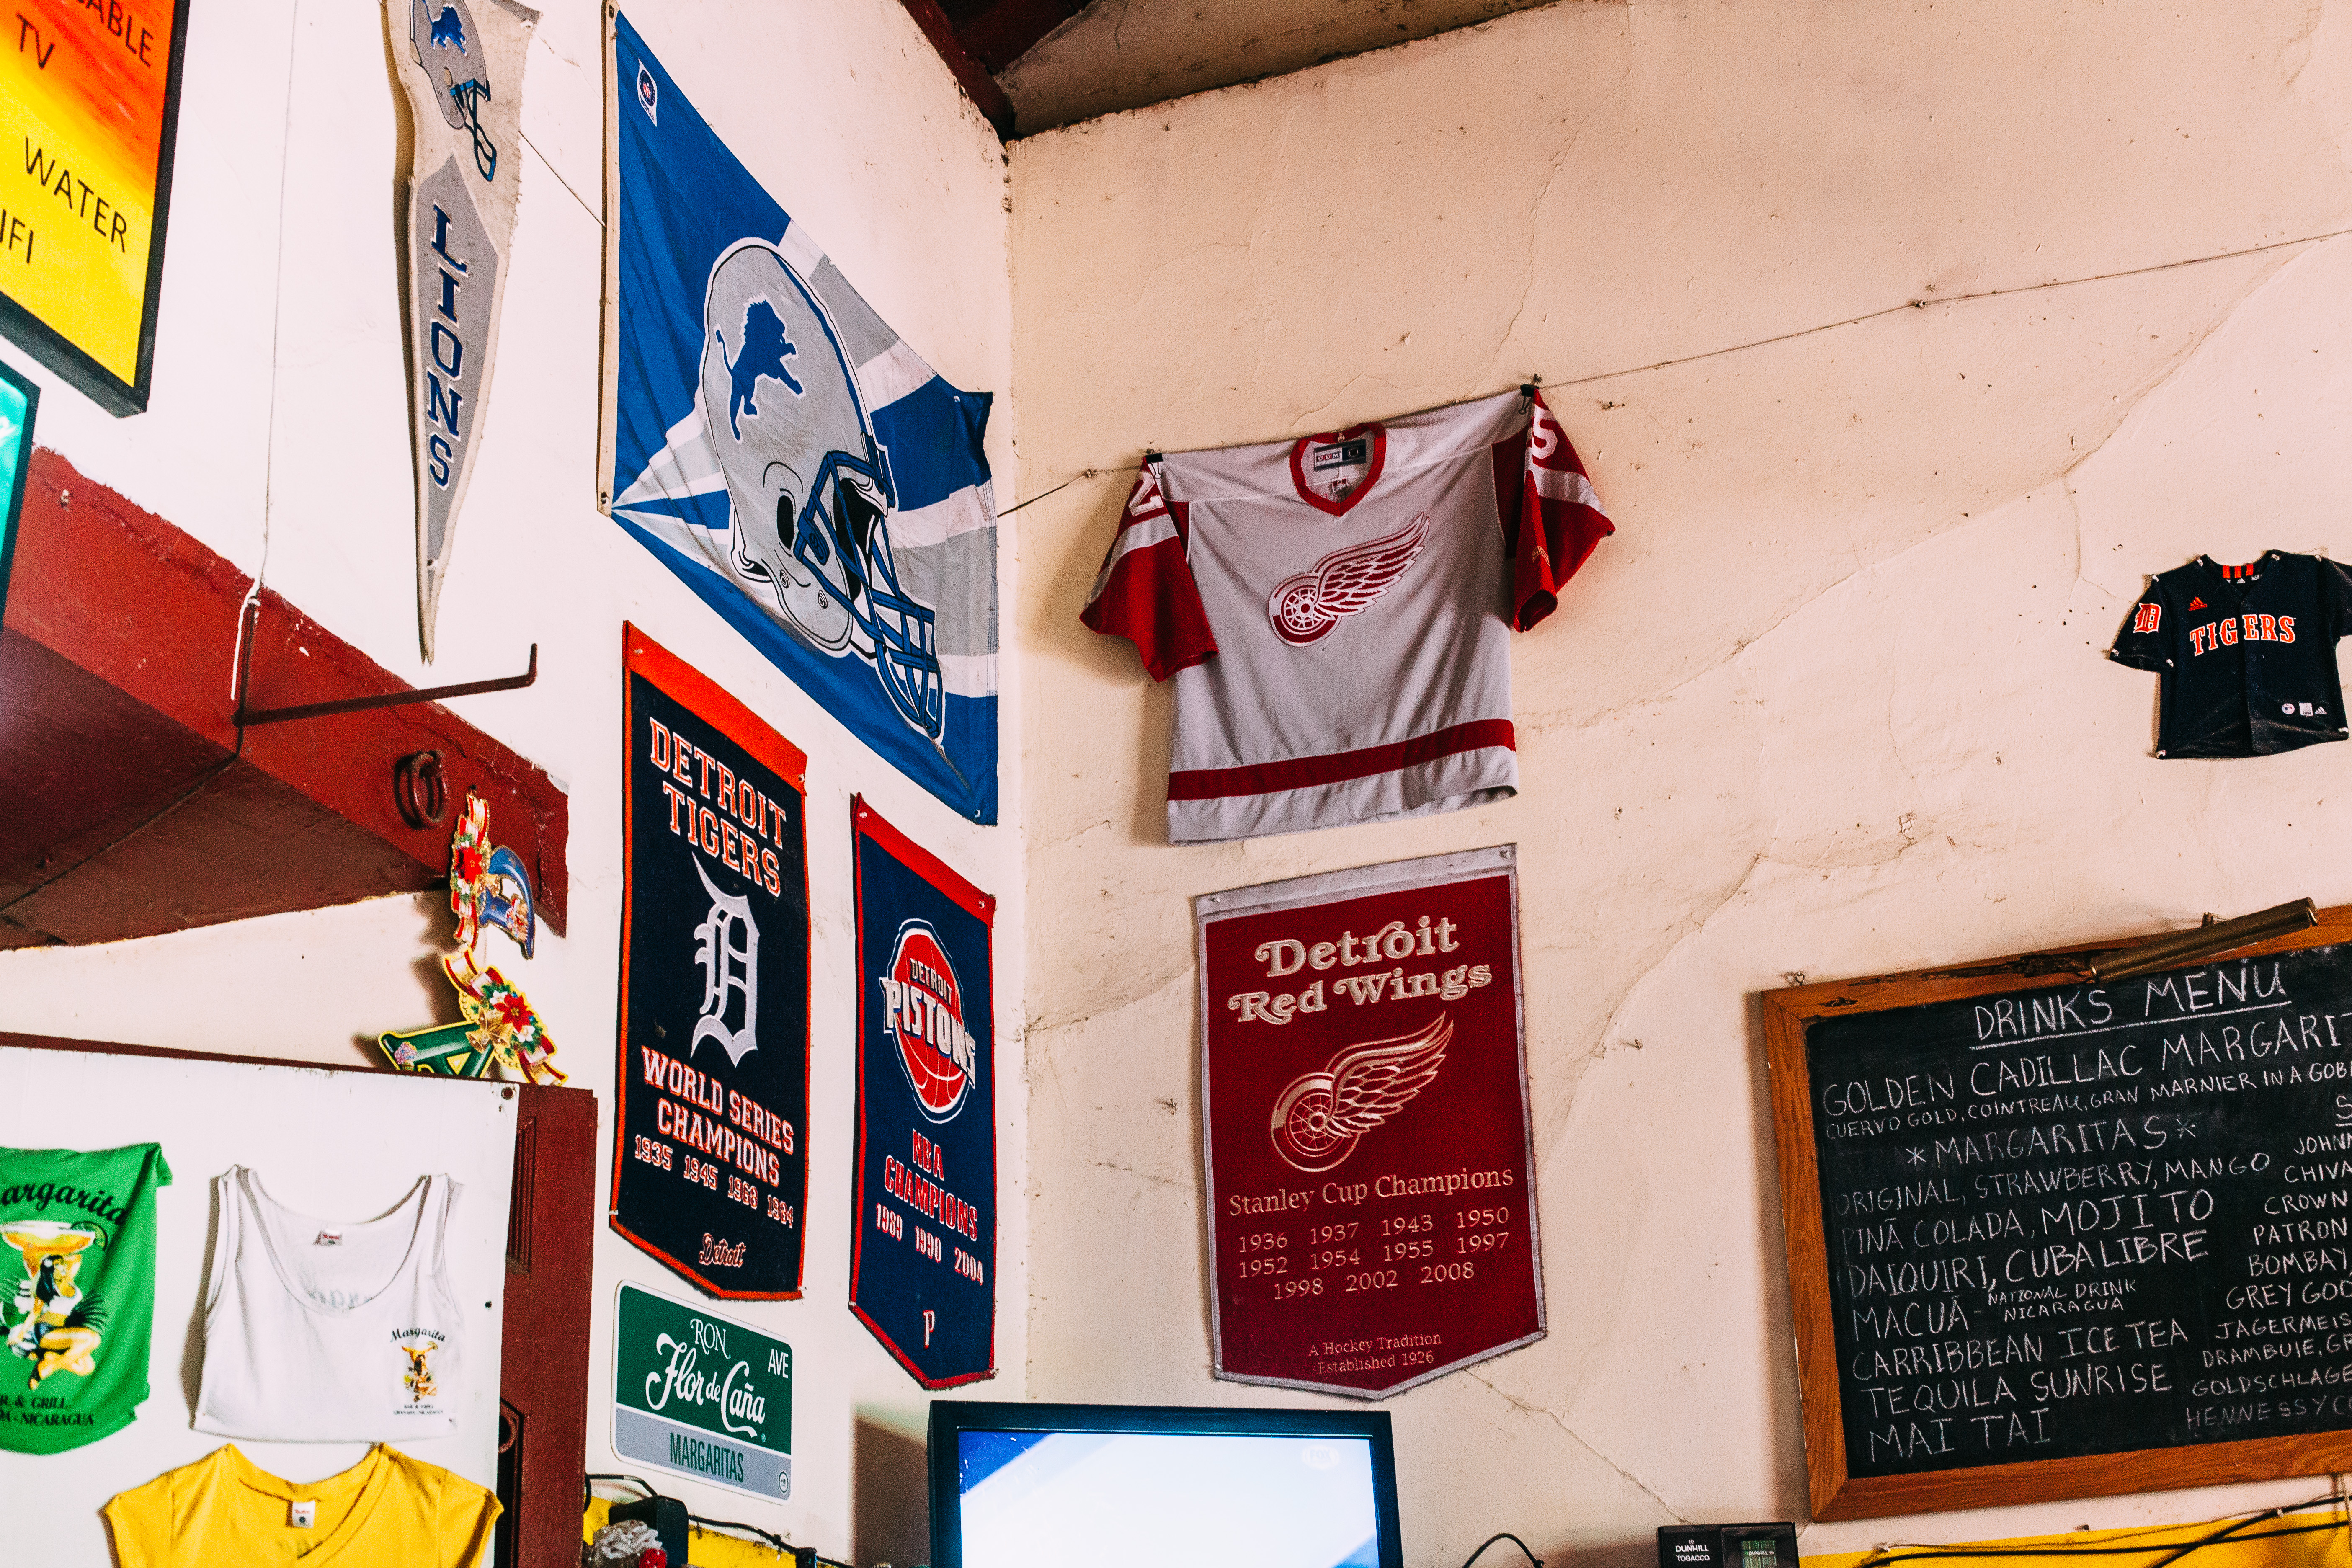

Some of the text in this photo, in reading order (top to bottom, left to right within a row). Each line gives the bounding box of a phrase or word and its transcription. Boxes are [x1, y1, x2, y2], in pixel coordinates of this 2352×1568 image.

[16, 12, 55, 69] TV
[77, 0, 154, 68] ABLE
[25, 136, 127, 253] WATER
[427, 200, 468, 490] LIONS
[2189, 614, 2296, 657] TIGERS
[650, 717, 787, 849] DETROIT
[663, 781, 781, 897] TIGERS
[1254, 915, 1460, 978] Detroit
[910, 957, 953, 1007] DETROIT
[1227, 964, 1493, 1025] Red Wings
[1974, 962, 2287, 1041] DRINKS MENU
[879, 977, 976, 1089] PISTONS
[642, 1045, 794, 1155] WORLD SERIES
[1823, 1069, 1955, 1117] GOLDEN
[1971, 1044, 2143, 1096] CADILLAC
[1826, 1117, 1901, 1140] CUERVO
[1908, 1108, 1964, 1127] GOLD,
[2151, 1072, 2257, 1101] MARNIER
[2263, 1070, 2283, 1087] IN
[2290, 1065, 2303, 1083] A
[657, 1098, 780, 1187] CHAMPIONS
[913, 1128, 944, 1181] NBA
[634, 1134, 794, 1229] 1935 1945 1968 1984
[884, 1155, 978, 1242] CHAMPIONS
[1230, 1167, 1514, 1216] Stanley Cup Champions
[1838, 1178, 1967, 1215] ORIGINAL,
[2165, 1153, 2270, 1183] MANGO
[2264, 1189, 2348, 1215] CROWN
[876, 1202, 983, 1286] 1989 1990 2004
[1239, 1207, 1509, 1253] 1936 1937 1943 1950
[1914, 1209, 2035, 1248] COLADA,
[2041, 1189, 2214, 1236] MOJITO
[2253, 1217, 2347, 1246] PATRON
[699, 1233, 746, 1268] Detroit
[1239, 1232, 1509, 1278] 1952 1954 1955 1997
[1274, 1261, 1475, 1300] 1998 2002 2008
[1988, 1279, 2137, 1306] NATIONAL DRINK
[2226, 1282, 2291, 1309] GREY
[389, 1328, 446, 1343] Margarita
[923, 1309, 935, 1349] P
[2004, 1297, 2124, 1323] NICARAGUA
[690, 1318, 731, 1360] RON
[768, 1348, 789, 1379] AVE
[1308, 1333, 1442, 1357] A Hockey Tradition
[1318, 1349, 1434, 1375] Established 1926
[1852, 1318, 2189, 1381] CARRIBBEAN ICE TEA
[645, 1333, 766, 1438] Flor de Caña
[1860, 1362, 2174, 1418] TEQUILA SUNRISE
[2186, 1394, 2328, 1430] HENNESSY
[670, 1432, 745, 1483] MARGARITAS
[1869, 1407, 2051, 1462] MAI TAI
[1675, 1544, 1709, 1553] DUNHILL
